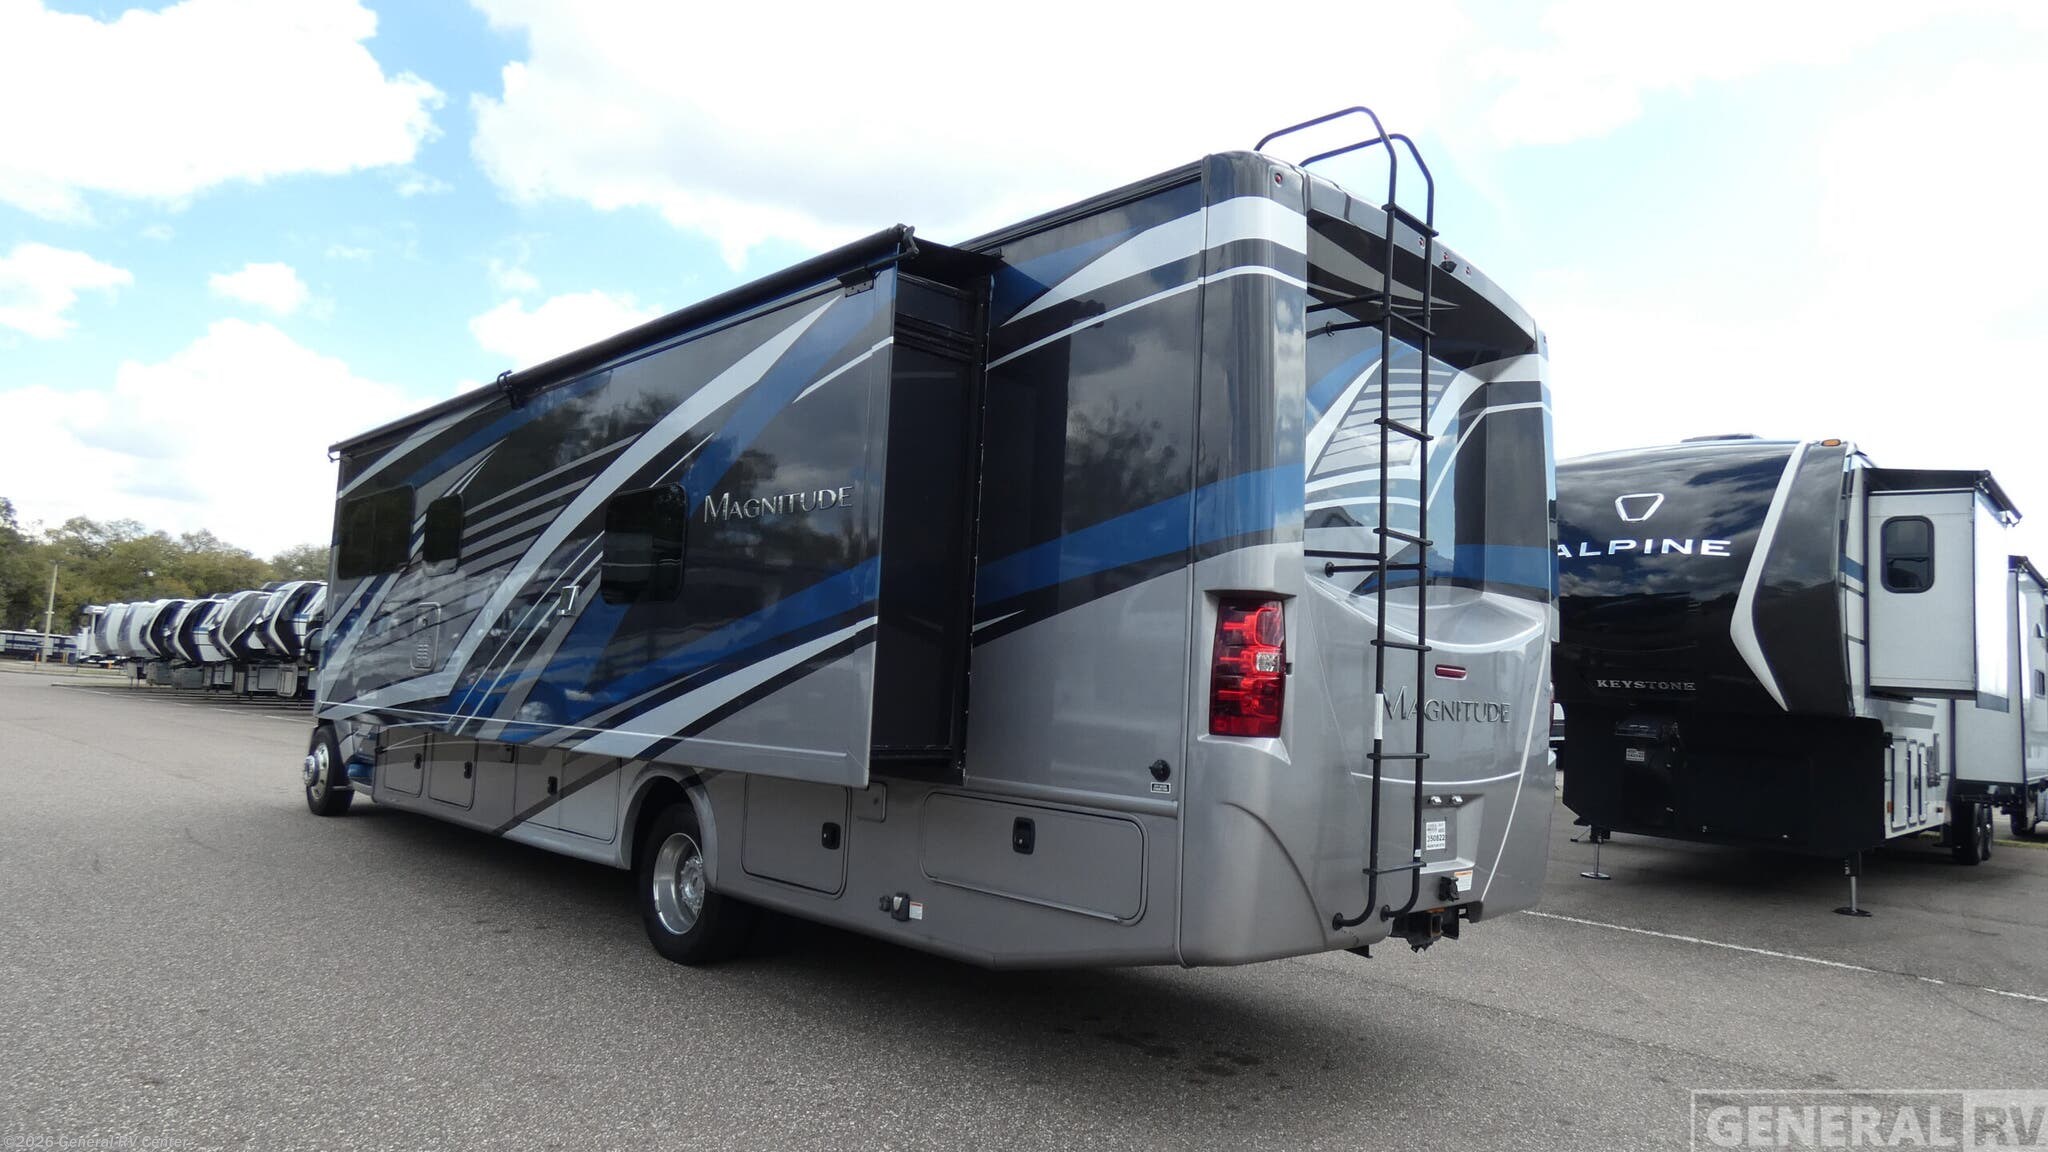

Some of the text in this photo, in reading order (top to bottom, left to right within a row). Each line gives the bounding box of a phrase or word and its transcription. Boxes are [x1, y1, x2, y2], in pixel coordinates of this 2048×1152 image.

[704, 486, 854, 523] MAGNITUDE
[1557, 538, 1732, 558] ALPINE
[1597, 679, 1696, 691] KEYSTONE
